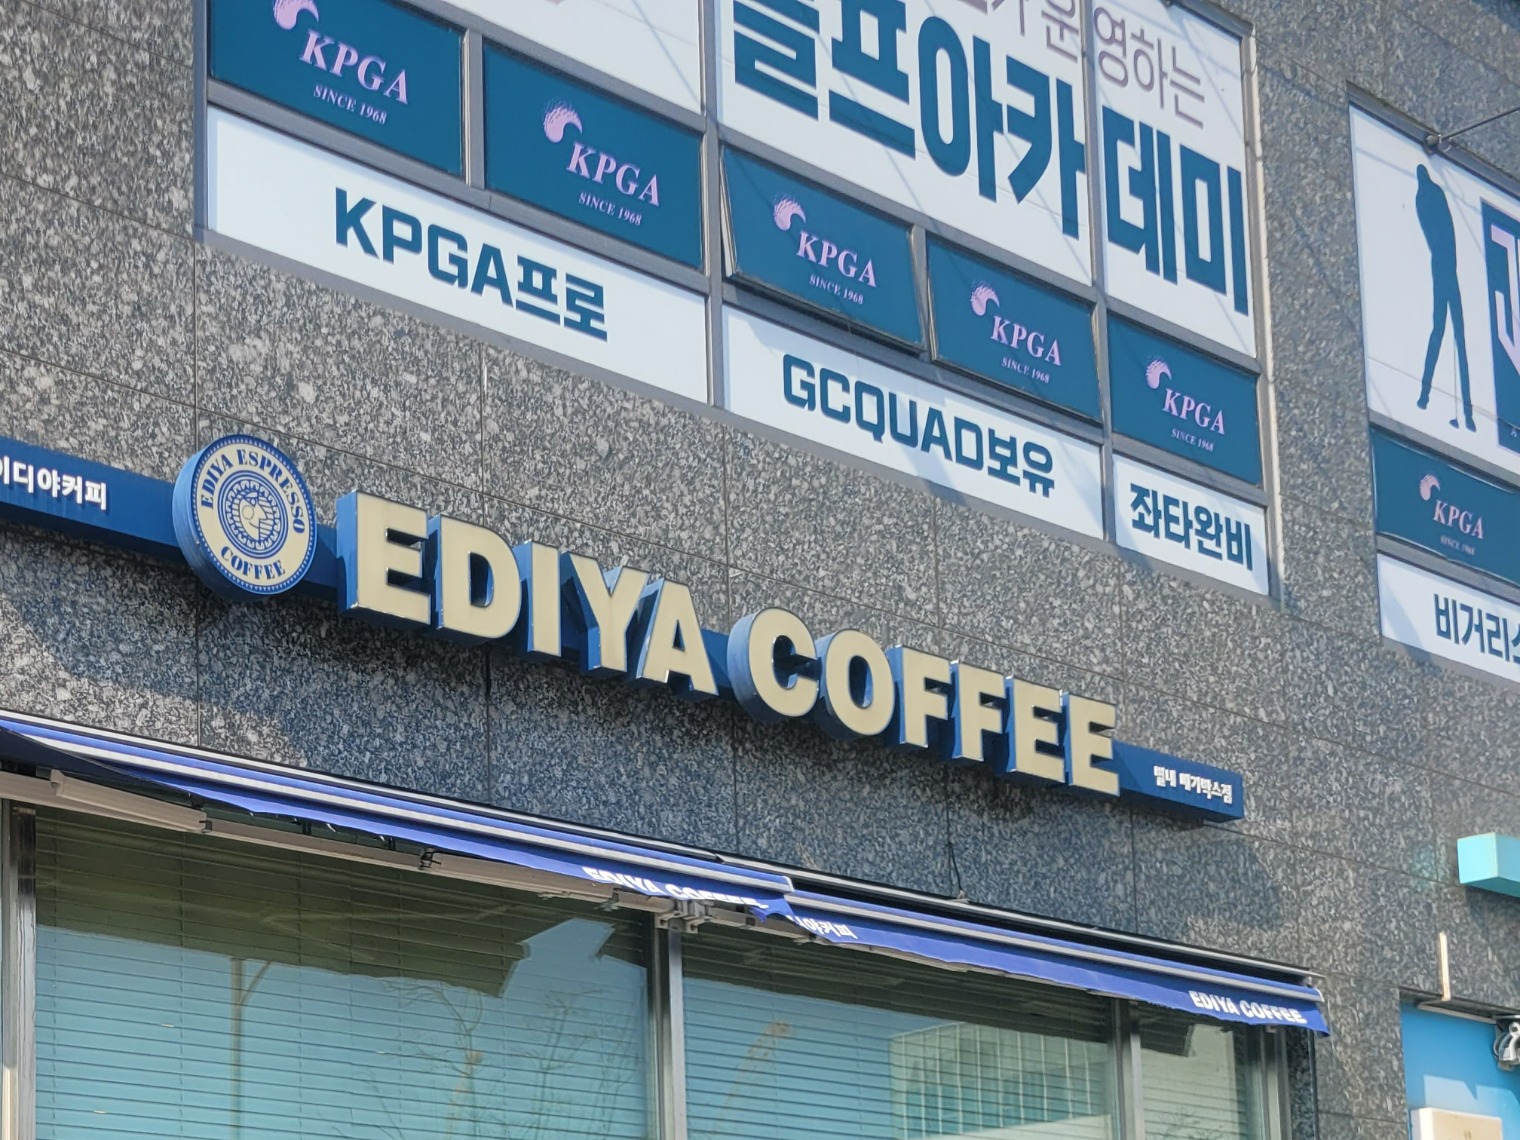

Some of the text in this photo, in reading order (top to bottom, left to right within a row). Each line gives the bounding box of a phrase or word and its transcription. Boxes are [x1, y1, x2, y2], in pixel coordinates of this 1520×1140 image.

[298, 28, 409, 105] KPGA
[312, 83, 388, 126] SINCE 1968
[565, 140, 661, 208] KPGA
[578, 190, 643, 227] SINCE 1968
[334, 185, 608, 343] KPGA프로
[795, 229, 878, 289] KPGA
[808, 272, 865, 306] SINCE 1968
[989, 314, 1063, 367] KPGA
[1001, 355, 1051, 385] SINCE 1968
[782, 353, 1056, 499] GCQUAD보유
[1162, 388, 1227, 436] KPGA
[1171, 426, 1215, 454] SINCE 1968
[200, 448, 306, 535] EDIYA ESPRESSO
[1130, 481, 1254, 572] 좌타완비
[1432, 499, 1484, 541] KPGA
[220, 545, 287, 581] COFFEE
[350, 490, 1121, 797] EDIYA COFFEE
[1152, 765, 1233, 805] 별내 메가박스점
[1188, 990, 1308, 1025] EDIYA COFFEE
